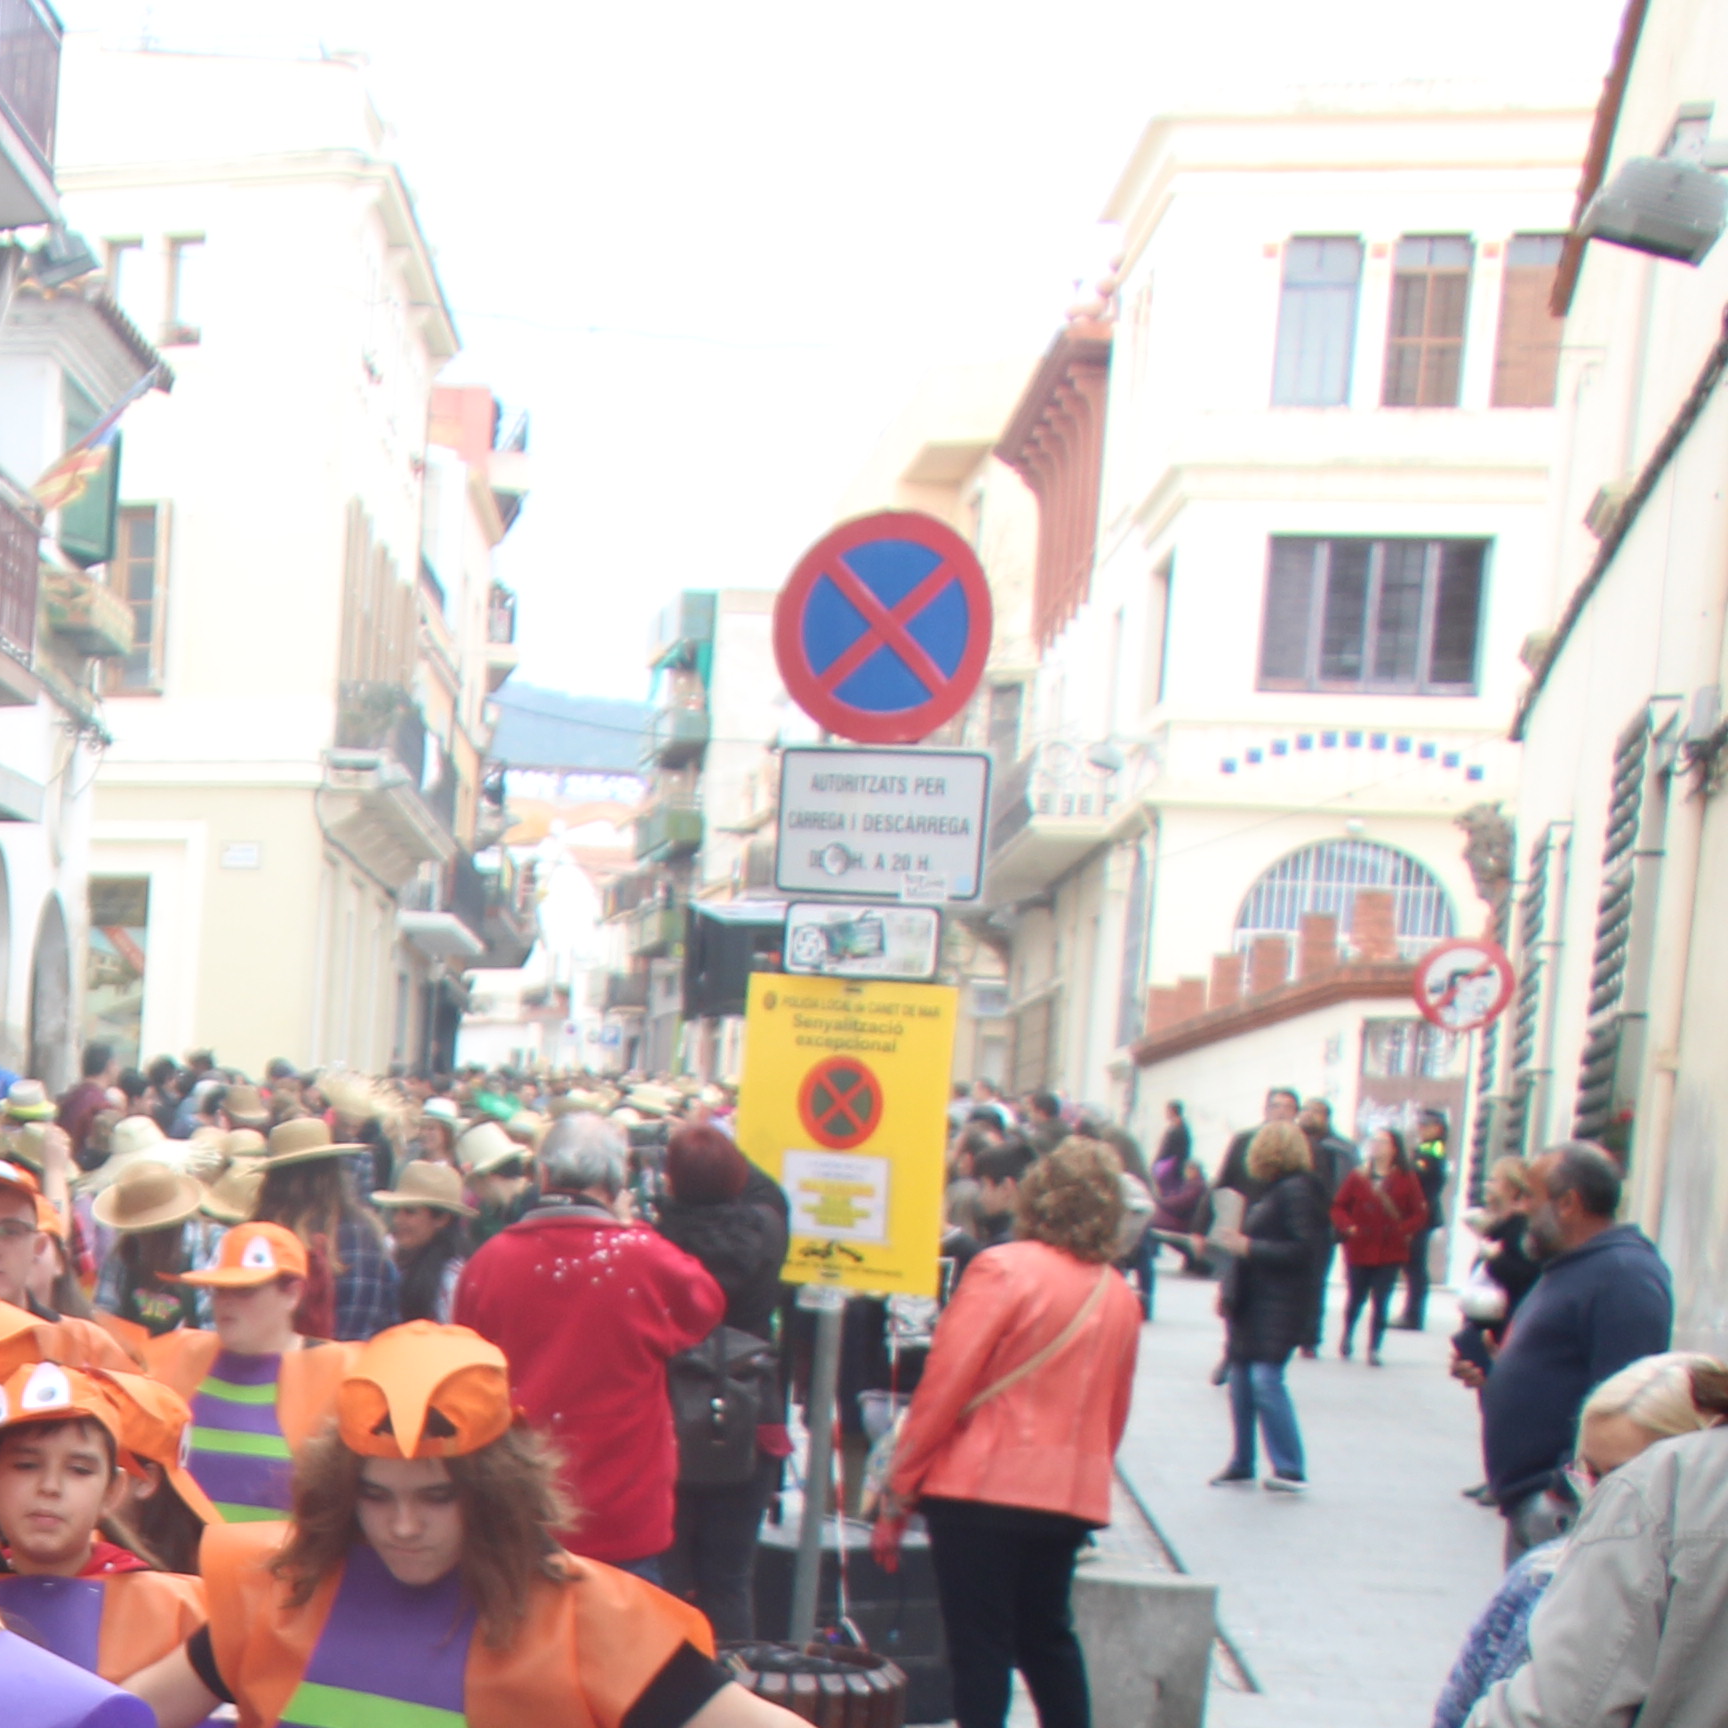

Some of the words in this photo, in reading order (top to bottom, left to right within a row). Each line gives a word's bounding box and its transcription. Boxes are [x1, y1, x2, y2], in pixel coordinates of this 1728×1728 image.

[810, 773, 908, 795] AUTORITZATS
[914, 777, 946, 796] PER
[850, 813, 856, 831] I
[873, 853, 885, 871] A
[891, 854, 911, 872] 20
[917, 855, 930, 872] H
[793, 1013, 904, 1035] Senyalització
[796, 1035, 897, 1053] excepcional
